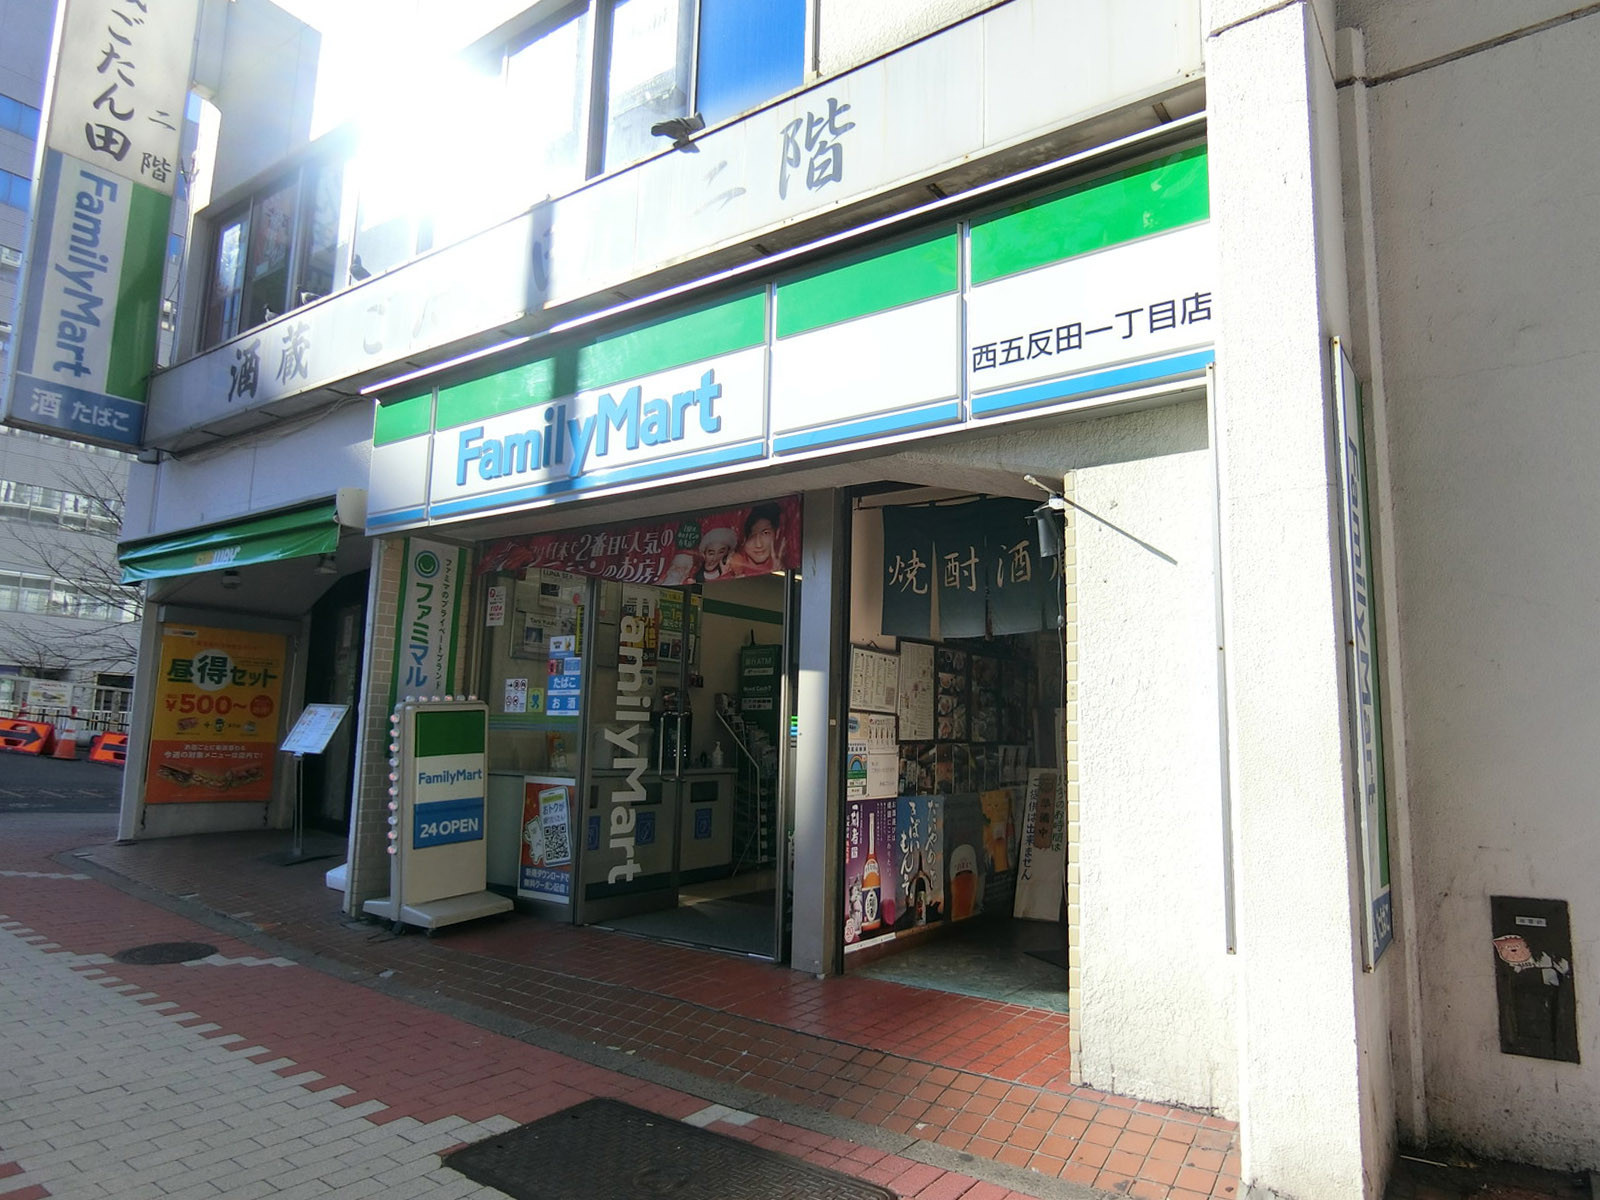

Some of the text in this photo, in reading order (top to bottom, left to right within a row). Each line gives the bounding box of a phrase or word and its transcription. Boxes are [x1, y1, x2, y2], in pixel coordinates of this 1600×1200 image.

[85, 0, 148, 162] ごたん田
[54, 170, 118, 379] FamilyMart
[972, 292, 1212, 373] 西五反田一丁目店
[71, 400, 130, 432] たばこ
[456, 368, 722, 486] FamilyMart
[405, 582, 434, 688] ファミマル
[1349, 436, 1375, 806] FamilyMart
[167, 655, 278, 688] 昼得セット
[553, 676, 577, 688] たばこ
[418, 768, 482, 785] FamilyMart
[604, 586, 659, 885] FamilyMart
[420, 818, 479, 838] 24 OPEN
